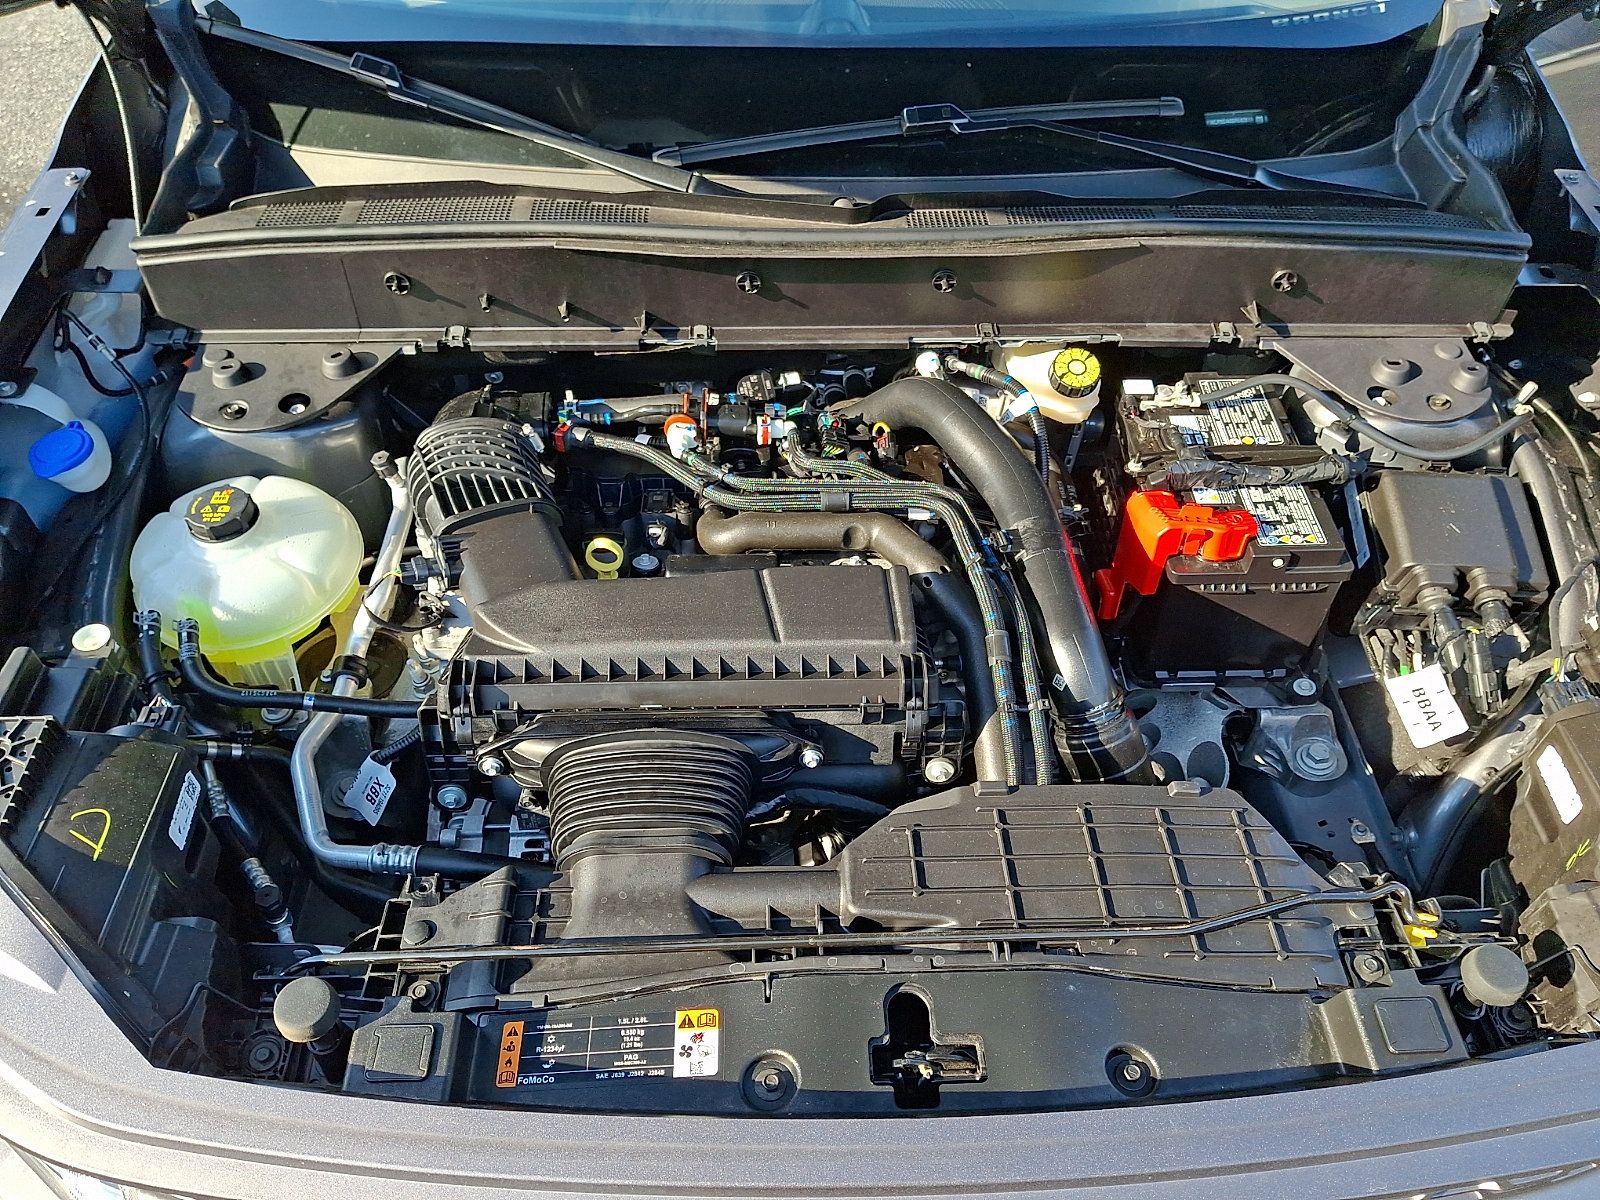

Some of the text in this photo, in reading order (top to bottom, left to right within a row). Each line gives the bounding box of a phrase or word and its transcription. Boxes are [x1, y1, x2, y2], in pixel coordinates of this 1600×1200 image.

[1411, 687, 1442, 732] BBAA
[535, 1044, 566, 1054] R-1234yf
[623, 1053, 639, 1061] PAG
[517, 1075, 555, 1086] FoMoCo
[595, 1072, 609, 1080] SAE
[611, 1071, 625, 1079] J639
